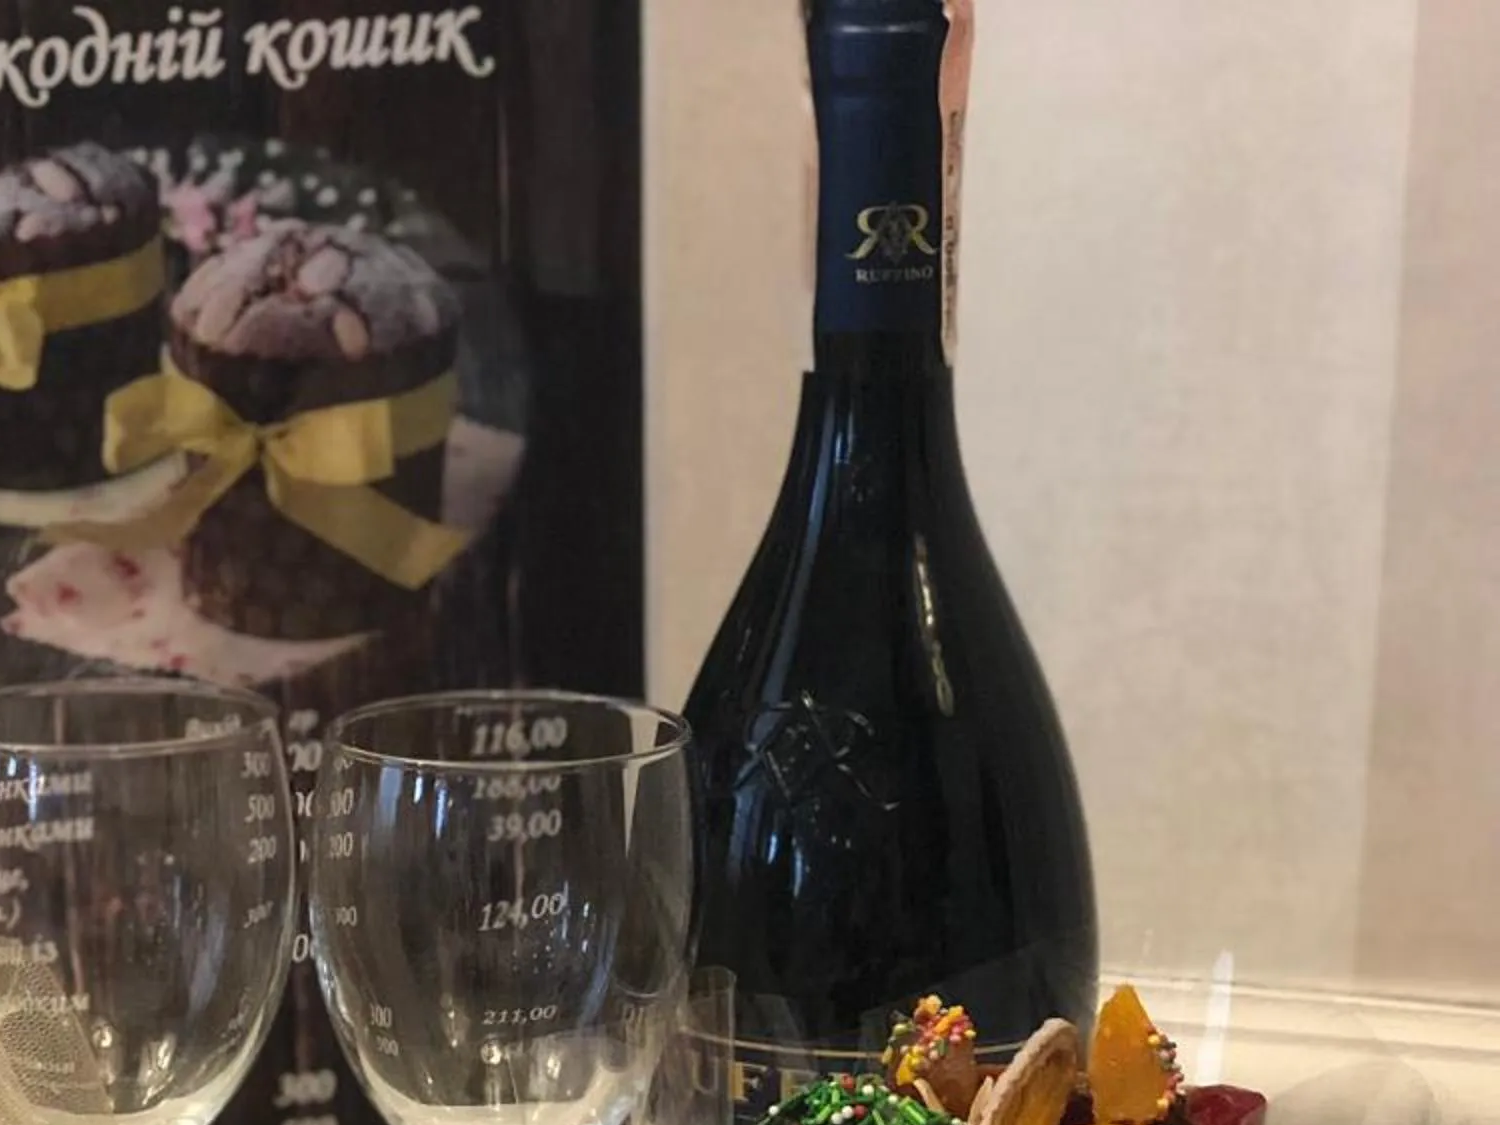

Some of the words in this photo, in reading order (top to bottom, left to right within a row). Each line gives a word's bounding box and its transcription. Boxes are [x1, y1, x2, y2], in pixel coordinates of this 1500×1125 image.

[243, 5, 495, 90] кошик
[471, 716, 568, 756] 116,00
[484, 808, 563, 842] 39,00
[478, 892, 567, 932] 124,00
